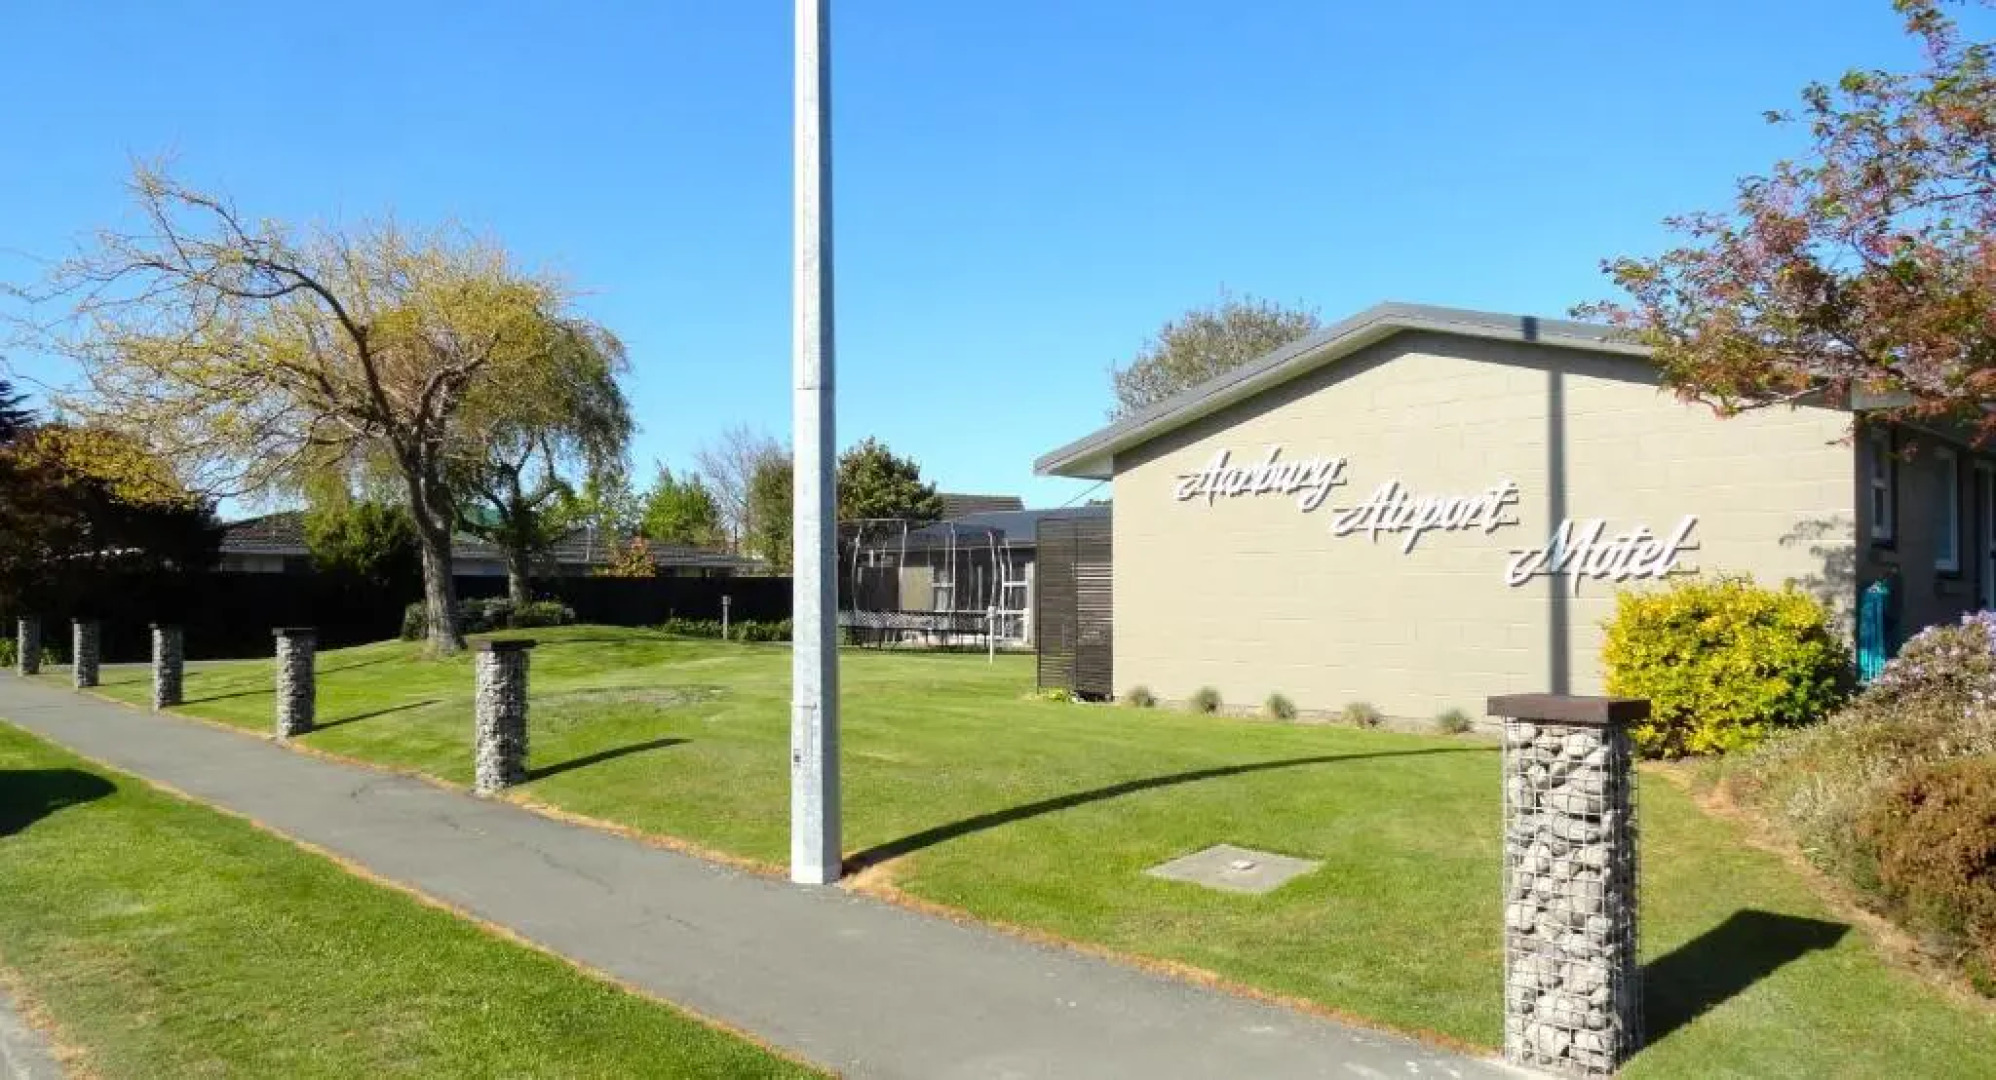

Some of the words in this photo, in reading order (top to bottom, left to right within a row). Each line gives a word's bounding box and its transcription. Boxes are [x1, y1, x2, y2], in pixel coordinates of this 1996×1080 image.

[1176, 447, 1346, 512] Aarburg
[1332, 479, 1518, 554] Airport
[1507, 515, 1699, 596] Motel
